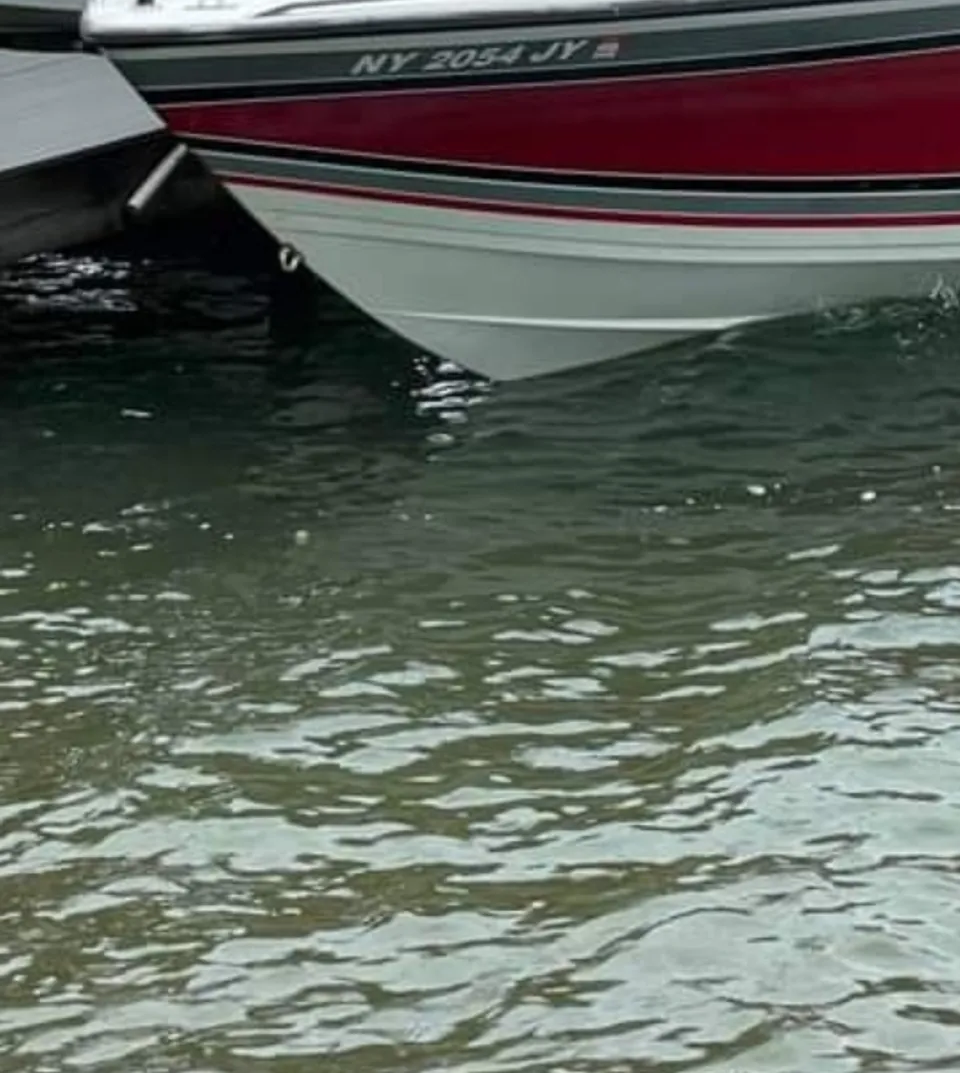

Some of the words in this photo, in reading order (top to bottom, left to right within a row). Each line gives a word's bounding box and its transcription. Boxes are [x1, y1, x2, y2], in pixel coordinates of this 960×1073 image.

[350, 52, 419, 75] NY
[422, 45, 525, 71] 2054
[528, 39, 590, 63] JY
